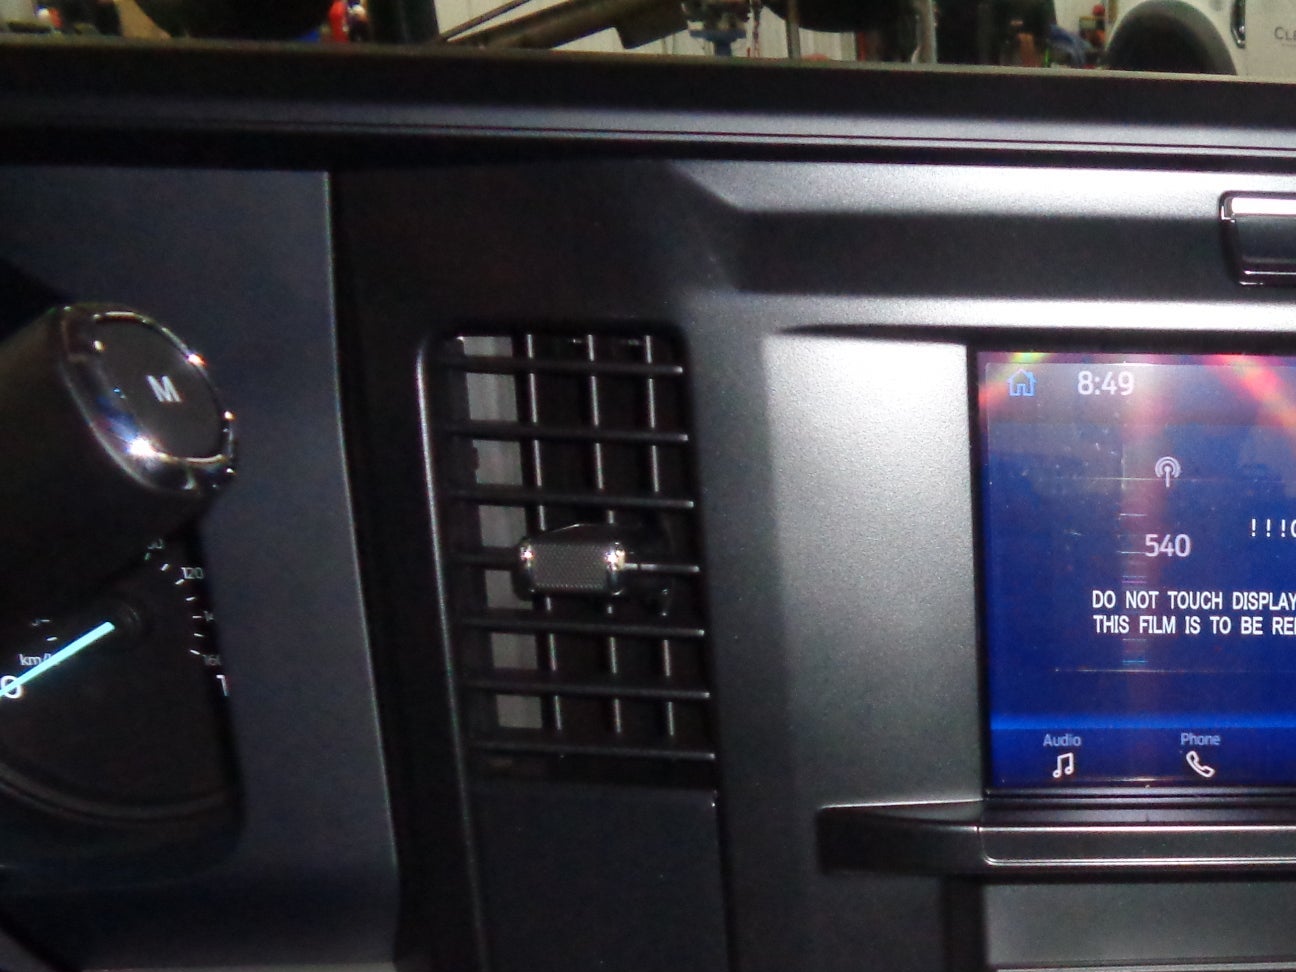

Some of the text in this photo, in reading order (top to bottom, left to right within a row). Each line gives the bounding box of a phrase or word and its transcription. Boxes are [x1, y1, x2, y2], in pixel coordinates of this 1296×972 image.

[148, 376, 181, 402] M
[1077, 371, 1134, 395] 8:49
[1145, 533, 1191, 558] 540
[1093, 590, 1116, 608] DO
[1126, 591, 1159, 608] NOT
[1167, 591, 1222, 609] TOUCH
[1093, 615, 1129, 633] THIS
[1140, 616, 1175, 633] FILM
[1185, 616, 1200, 634] IS
[1210, 616, 1231, 634] TO
[1241, 616, 1263, 635] BE
[1042, 732, 1082, 747] Audio
[1180, 733, 1221, 746] Phone
